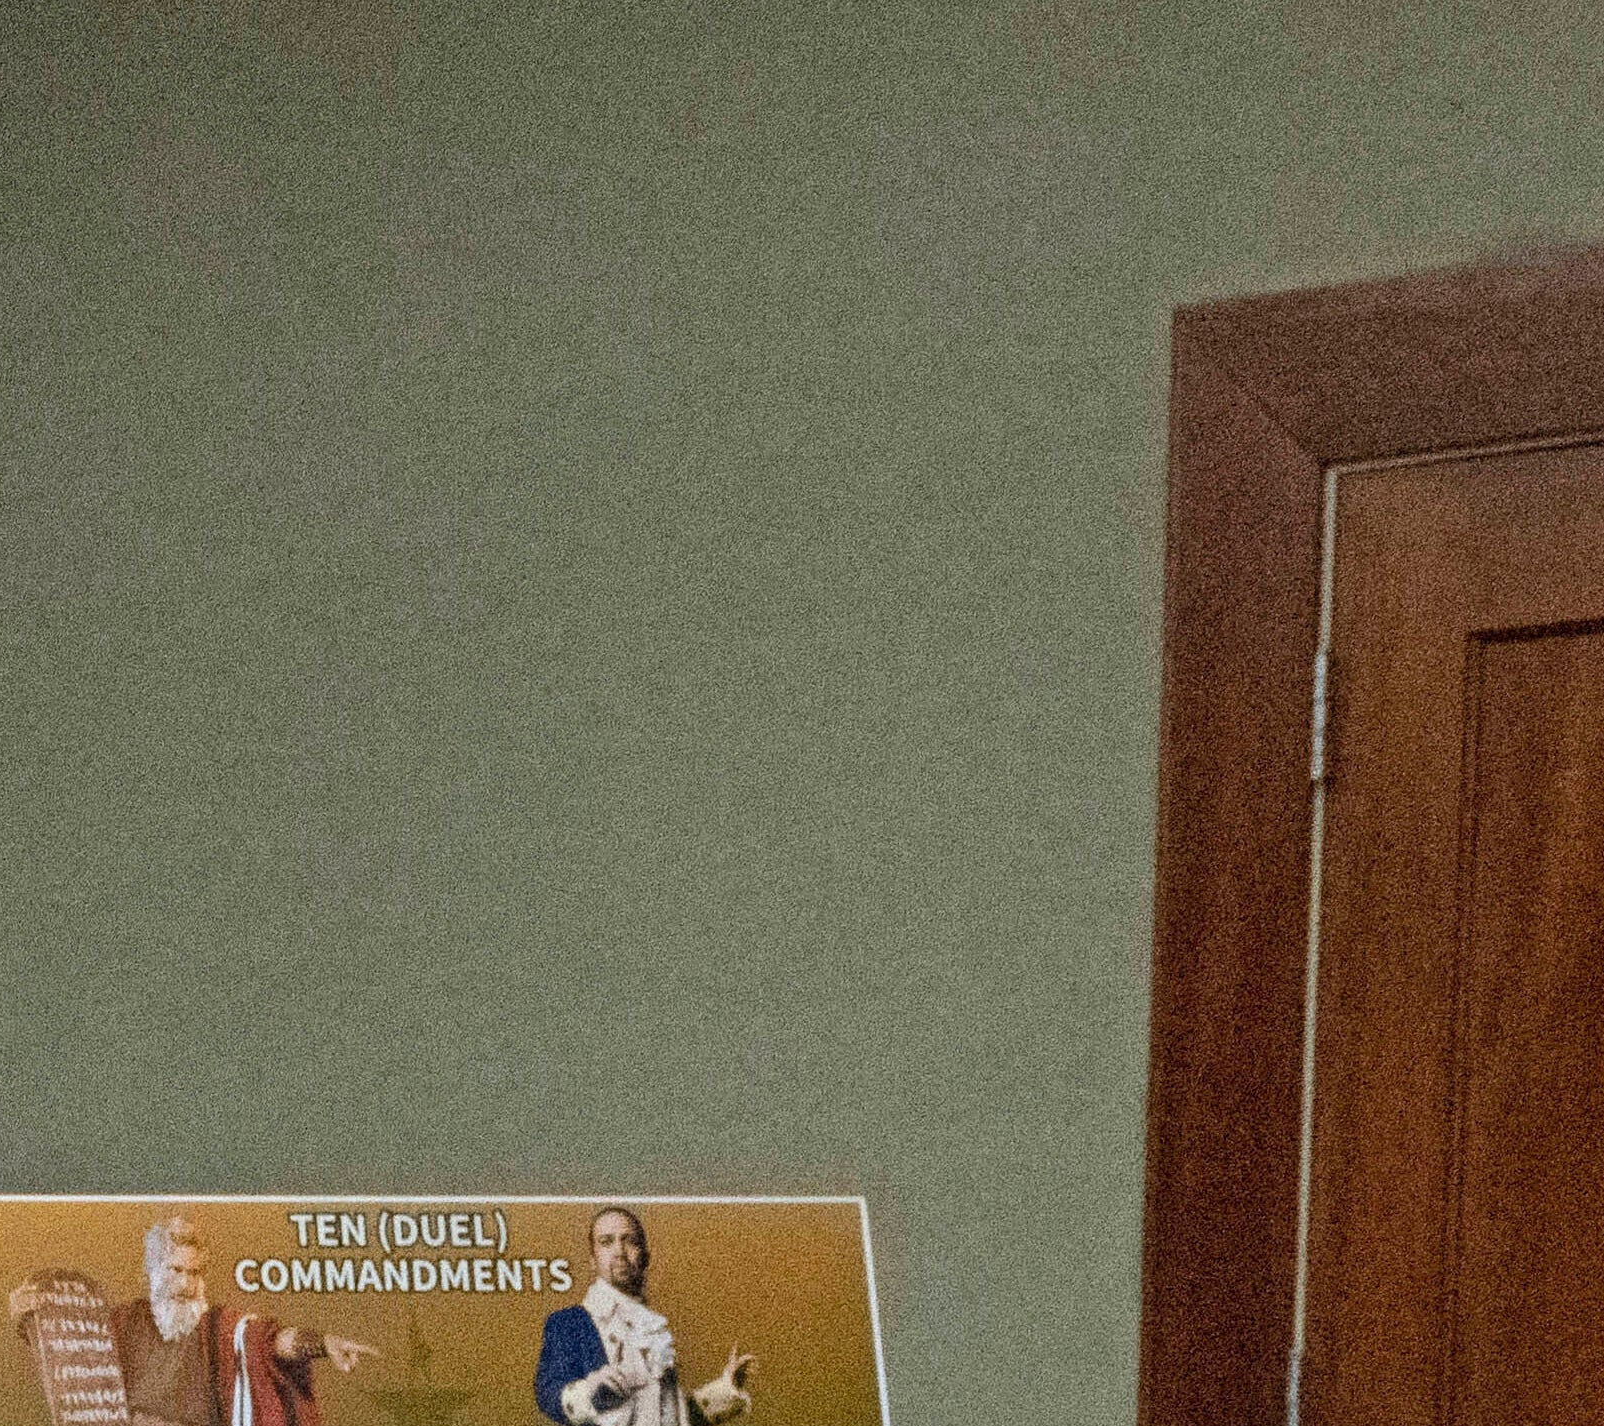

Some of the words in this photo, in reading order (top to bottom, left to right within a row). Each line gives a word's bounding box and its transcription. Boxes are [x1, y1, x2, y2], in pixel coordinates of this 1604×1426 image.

[289, 1214, 366, 1245] TEN
[378, 1212, 506, 1252] (DUEL)
[234, 1259, 572, 1291] COMMANDMENTS
